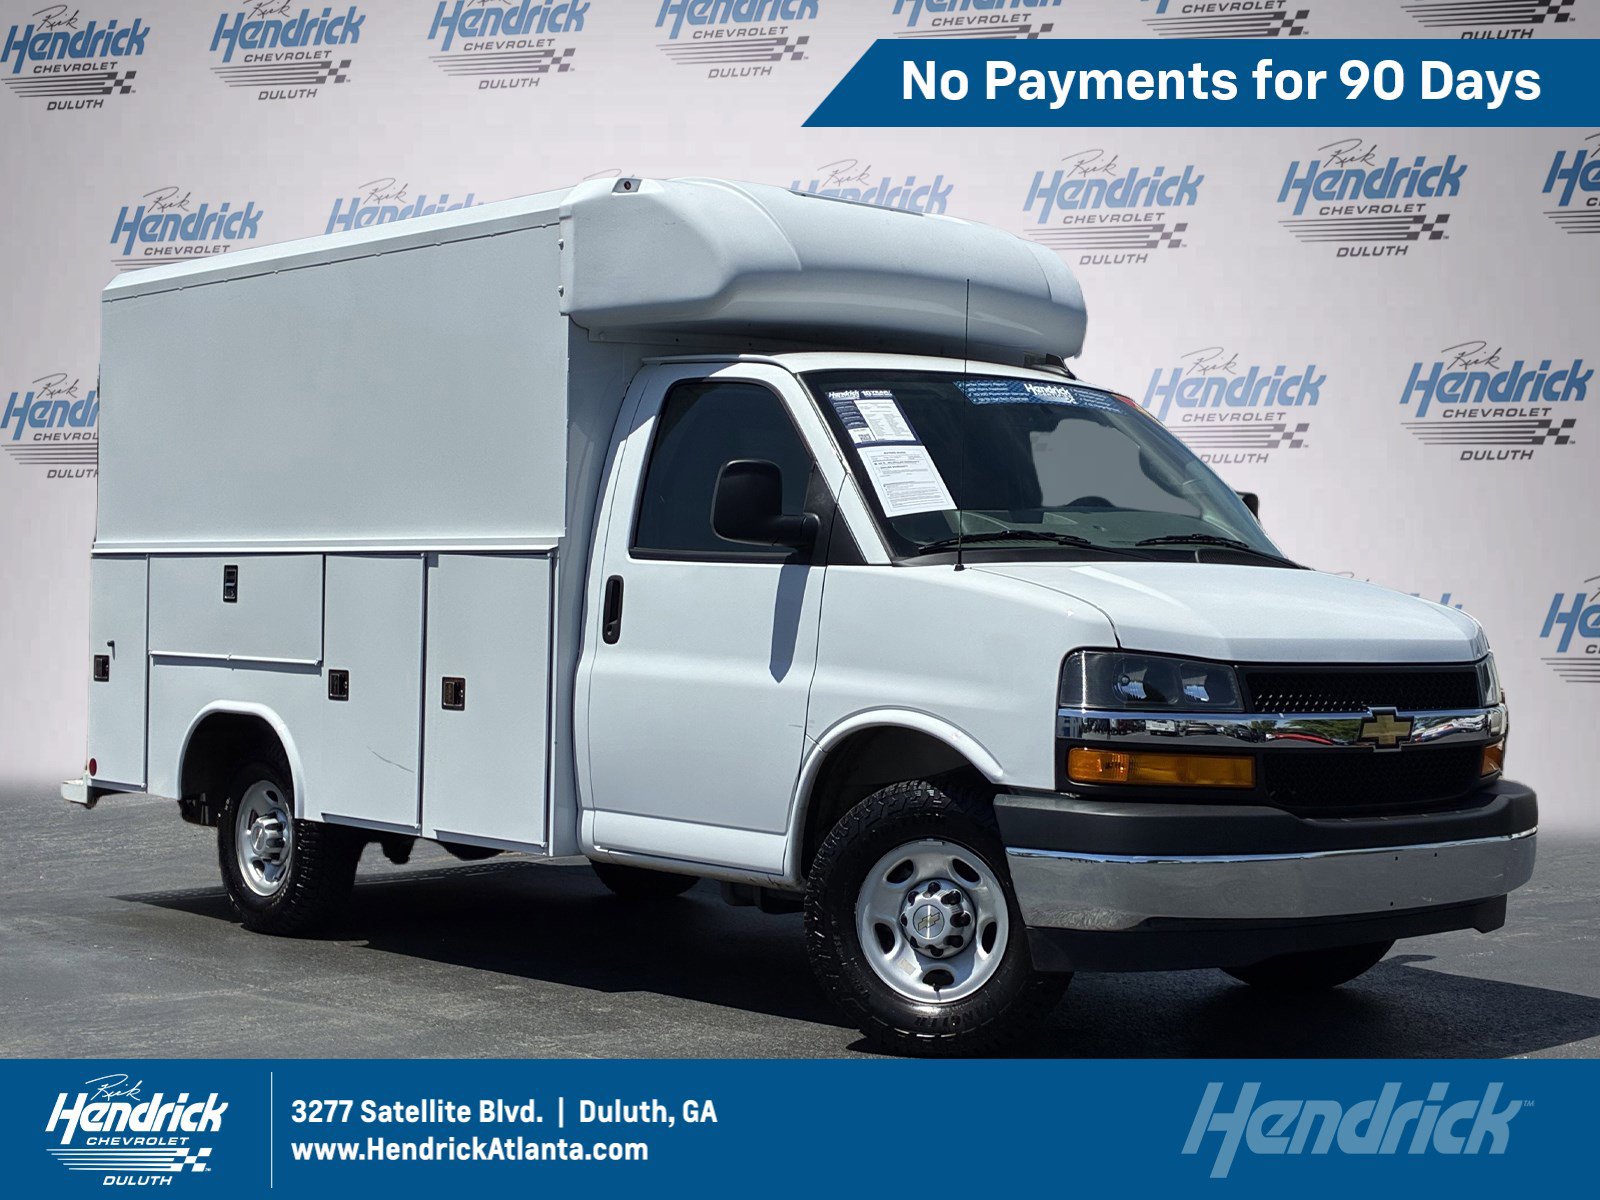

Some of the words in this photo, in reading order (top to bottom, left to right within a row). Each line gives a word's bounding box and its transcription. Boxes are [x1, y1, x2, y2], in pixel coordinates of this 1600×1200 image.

[1181, 0, 1287, 14] CHEVROLET
[427, 0, 591, 51] Hendrick
[931, 13, 1032, 27] CHEVROLET
[209, 5, 366, 63] Hendrick
[692, 26, 788, 39] CHEVROLET
[0, 18, 150, 74] Hendrick
[464, 38, 555, 51] CHEVROLET
[244, 50, 332, 63] CHEVROLET
[33, 62, 118, 74] CHEVROLET
[708, 66, 772, 78] DULUTH
[478, 77, 540, 89] DULUTH
[257, 88, 318, 101] DULUTH
[46, 99, 104, 111] DULUTH
[1277, 155, 1467, 216] Hendrick
[1023, 165, 1205, 224] Hendrick
[1319, 203, 1426, 215] CHEVROLET
[1062, 213, 1165, 224] CHEVROLET
[110, 201, 263, 255] Hendrick
[144, 245, 231, 255] CHEVROLET
[1336, 245, 1409, 257] DULUTH
[1079, 254, 1148, 265] DULUTH
[1142, 364, 1327, 421] Hendrick
[1399, 359, 1594, 418] Hendrick
[1182, 412, 1286, 422] CHEVROLET
[1442, 407, 1552, 418] CHEVROLET
[1460, 450, 1534, 461] DULUTH
